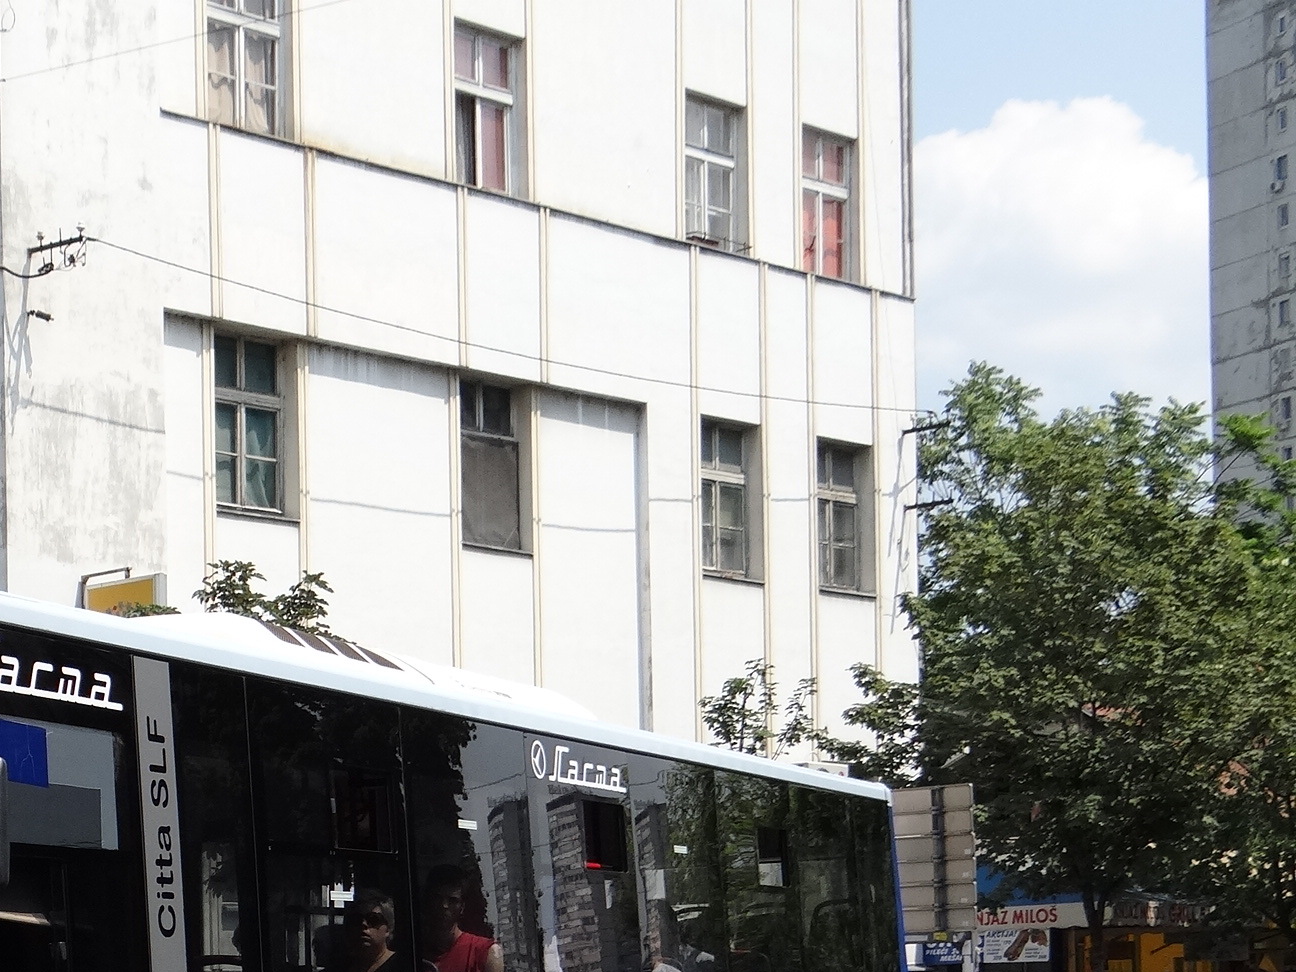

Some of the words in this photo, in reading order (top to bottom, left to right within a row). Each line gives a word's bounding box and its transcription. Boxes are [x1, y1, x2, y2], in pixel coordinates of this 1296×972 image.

[146, 715, 170, 808] SLF
[155, 825, 177, 938] Citta
[1012, 906, 1058, 924] MILOŠ
